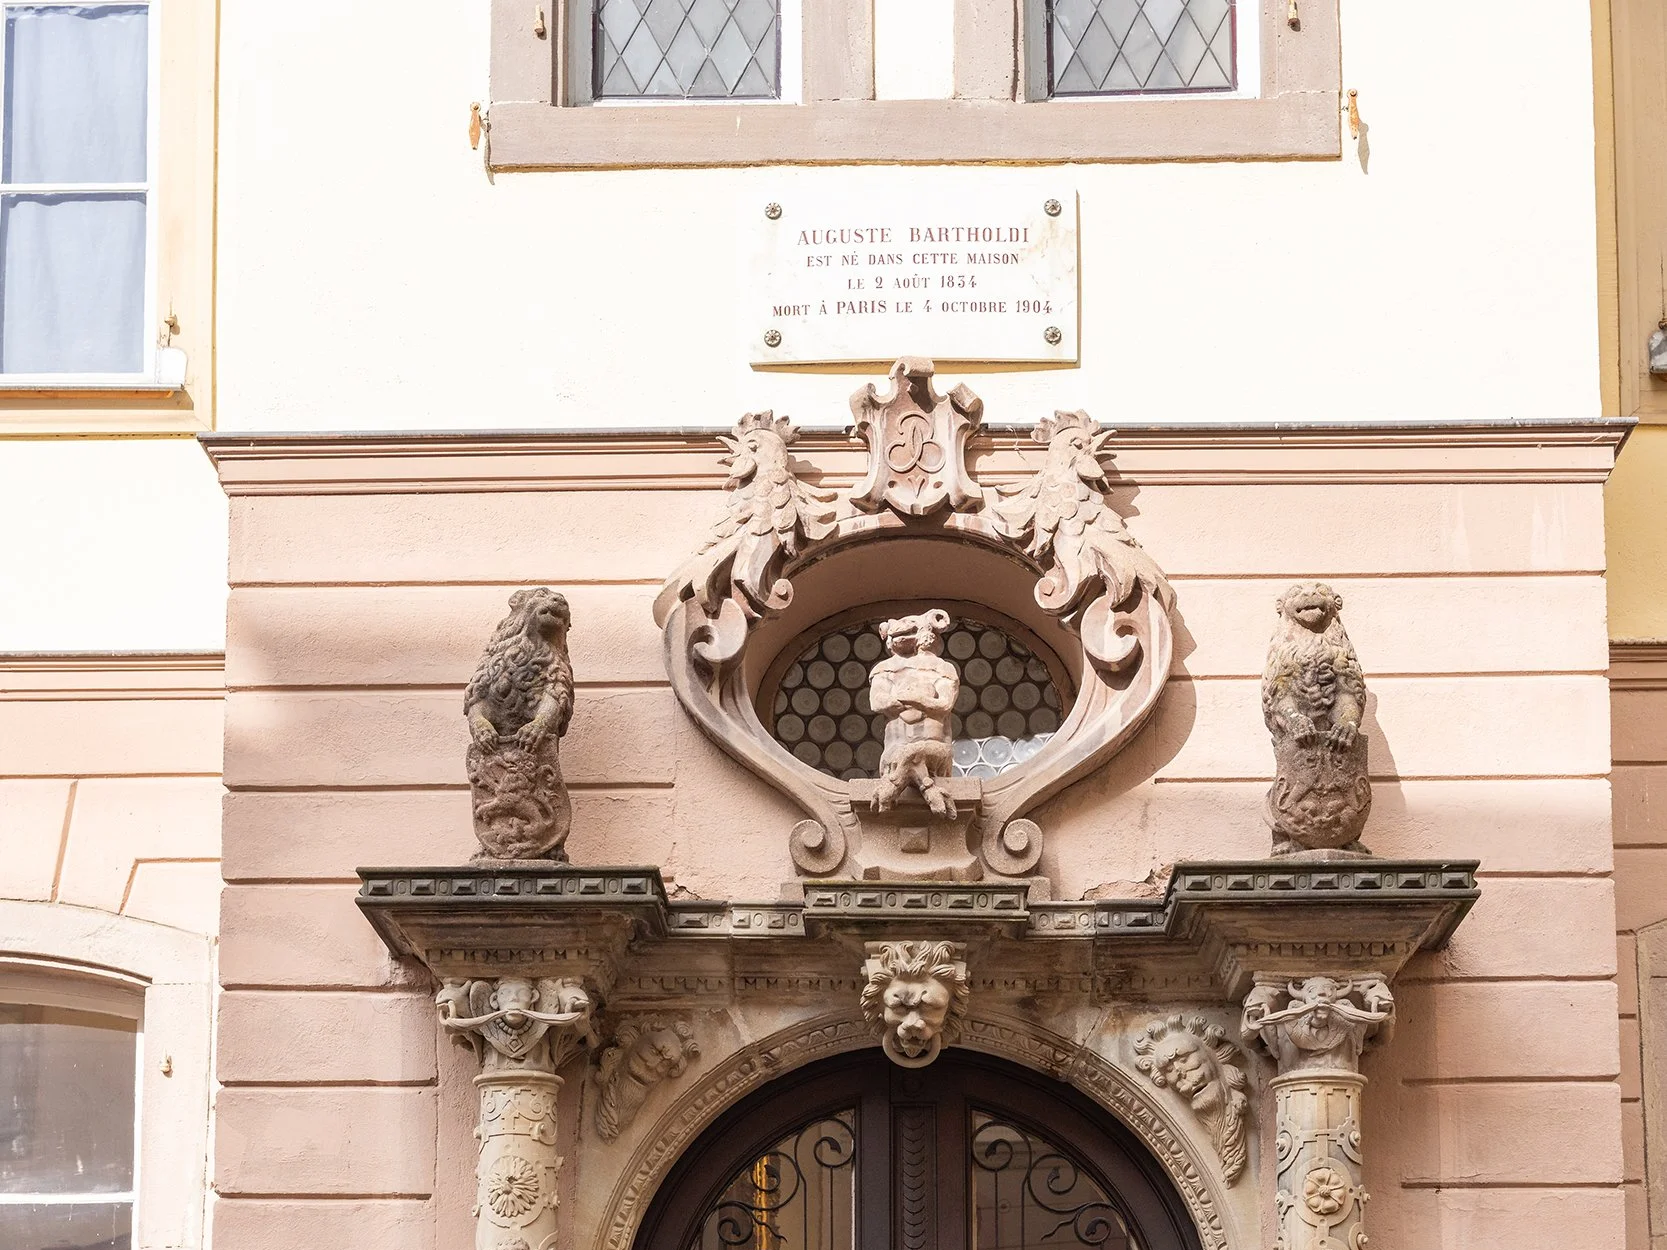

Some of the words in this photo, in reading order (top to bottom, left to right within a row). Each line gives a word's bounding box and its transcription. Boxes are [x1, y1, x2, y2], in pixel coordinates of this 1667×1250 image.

[797, 226, 892, 245] AUGUSTE
[909, 226, 1030, 243] BARTHOLDI
[807, 255, 832, 267] EST
[868, 253, 903, 265] DANS
[912, 253, 958, 265] CETTE
[966, 252, 1019, 265] MAISON
[848, 278, 865, 290] LE
[875, 276, 883, 289] 2
[893, 273, 930, 289] AOÛT
[940, 275, 977, 289] 1834
[772, 304, 811, 317] MORT
[836, 300, 887, 315] PARIS
[896, 301, 913, 313] LE
[922, 300, 933, 313] 4
[941, 301, 1007, 313] OCTOBRE
[1015, 300, 1053, 314] 1904
